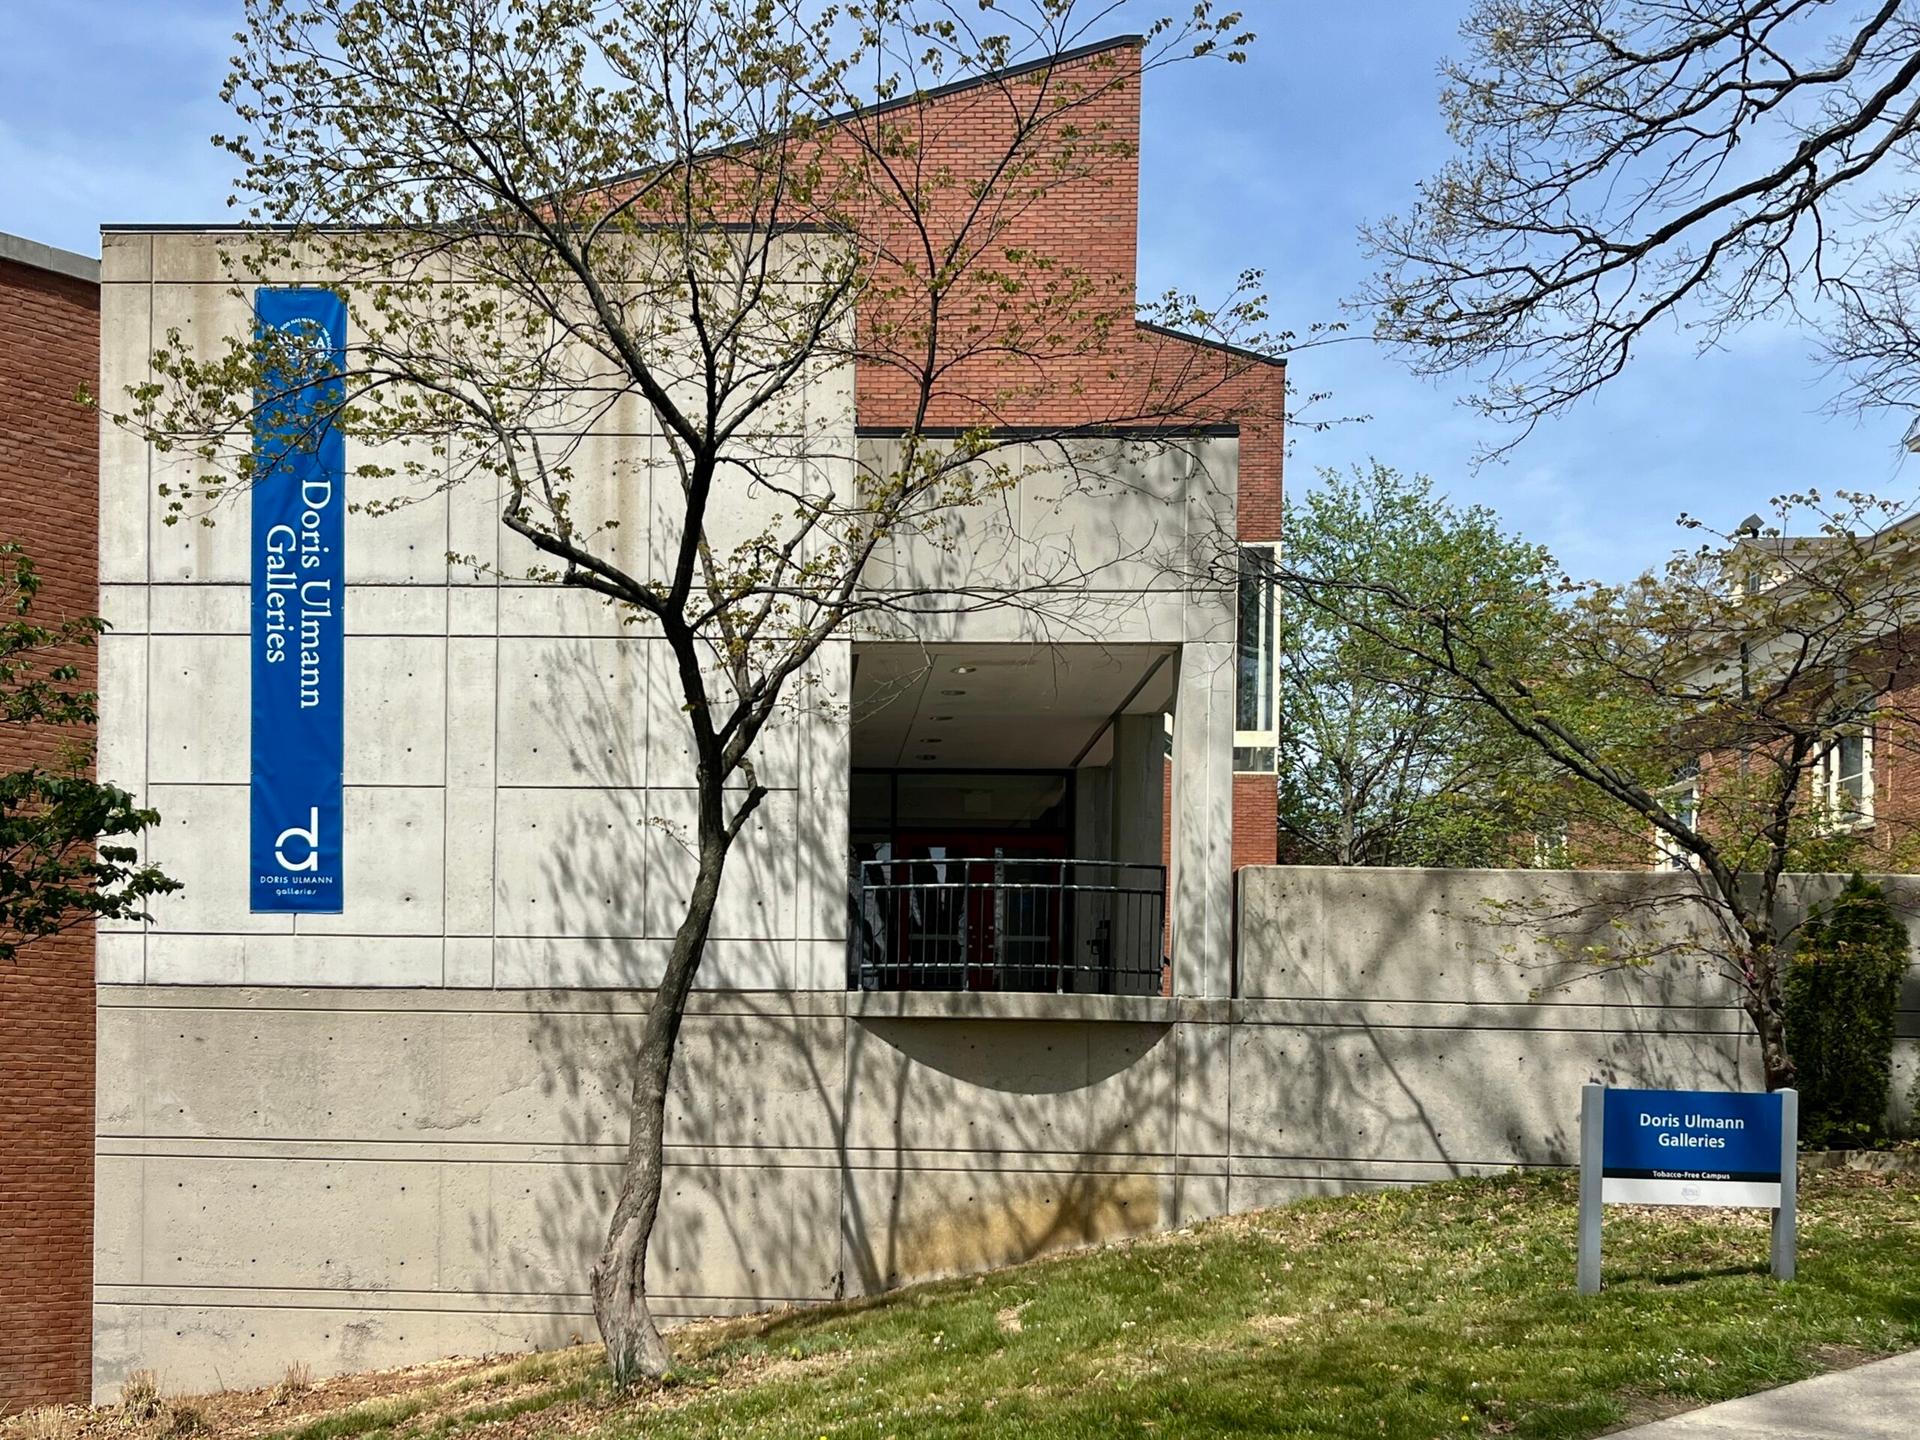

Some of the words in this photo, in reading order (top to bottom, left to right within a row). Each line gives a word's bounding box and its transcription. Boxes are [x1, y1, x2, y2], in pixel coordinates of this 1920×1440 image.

[301, 479, 331, 569] Doris
[266, 524, 298, 663] Galleries
[300, 579, 332, 709] Ulmann
[260, 875, 289, 884] DORIS
[292, 876, 333, 884] ULMANN
[1640, 1113, 1680, 1128] Doris
[1684, 1114, 1744, 1130] Ulmann
[1658, 1132, 1726, 1149] Galleries
[1652, 1170, 1700, 1179] Tobacco-Free
[1701, 1172, 1730, 1180] Campus
